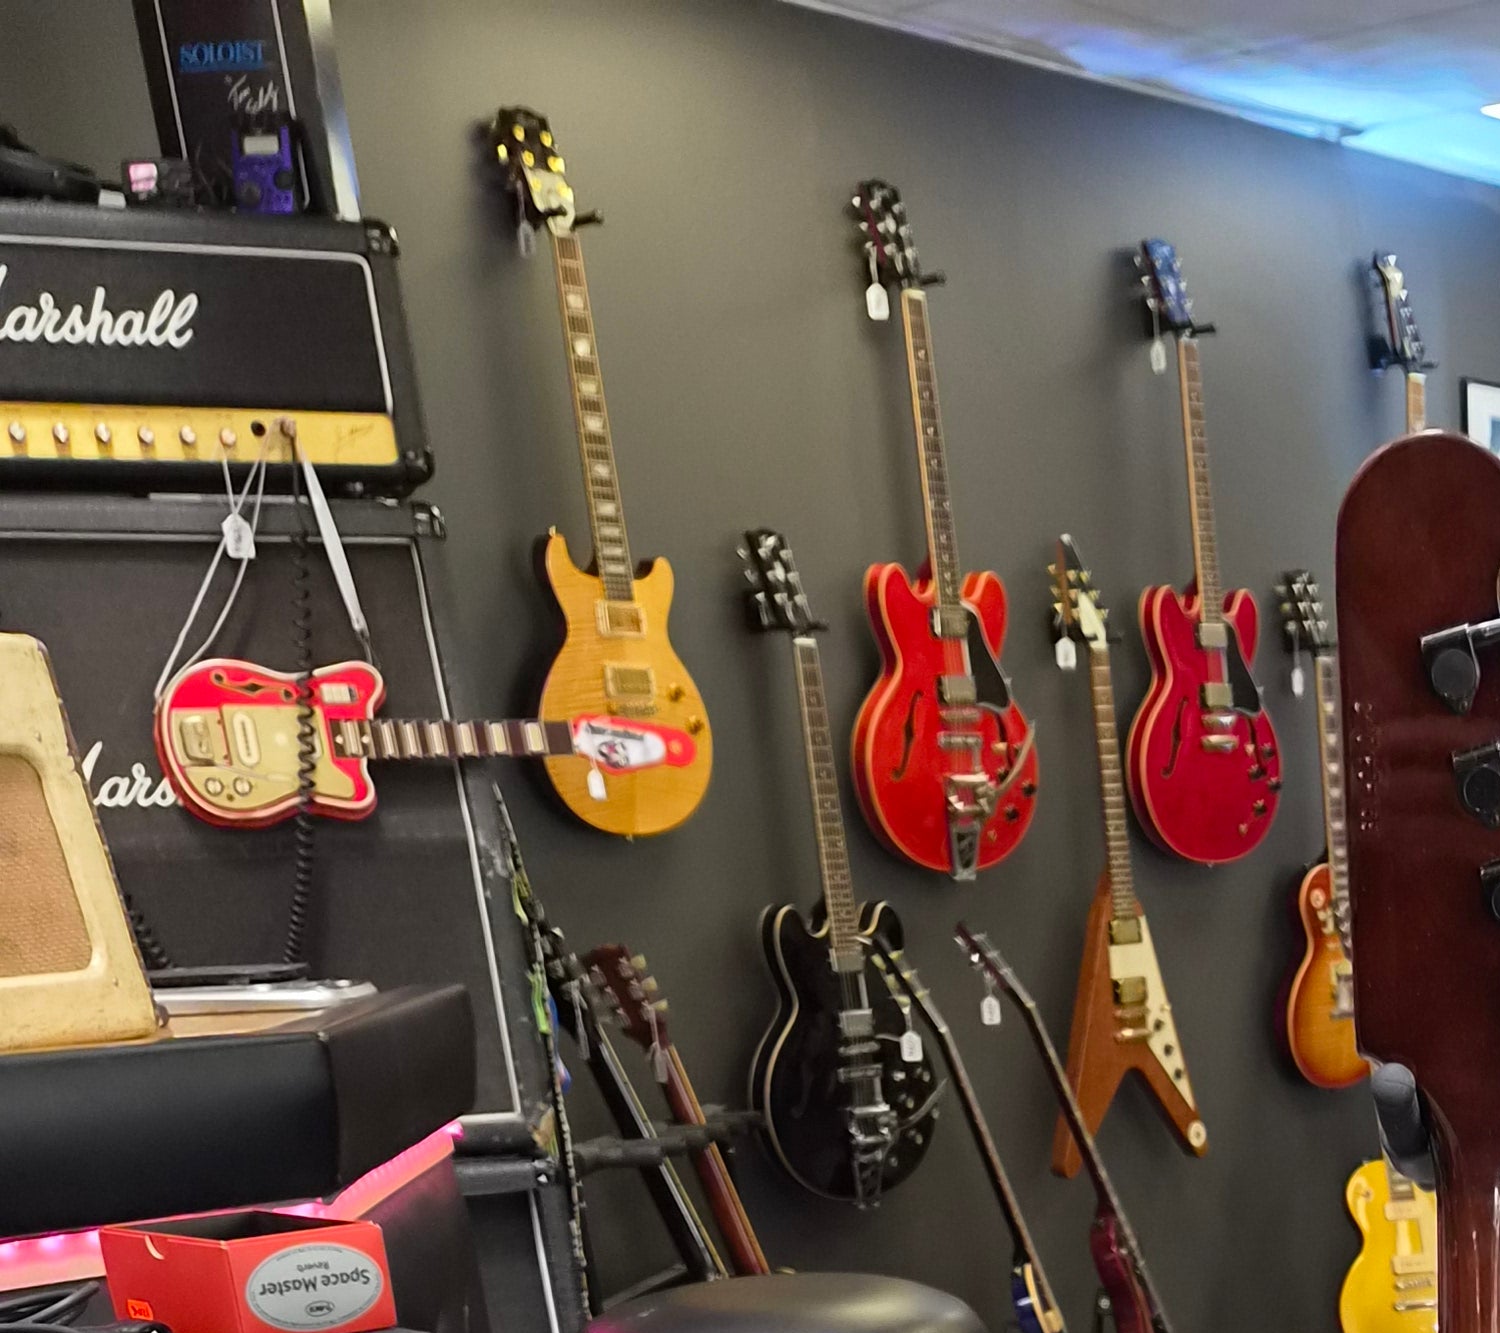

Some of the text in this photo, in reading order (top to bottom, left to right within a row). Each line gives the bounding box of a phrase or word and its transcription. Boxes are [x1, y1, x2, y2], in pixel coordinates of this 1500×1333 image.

[0, 263, 199, 349] arshall
[259, 1267, 370, 1296] Space Master
[297, 1261, 330, 1273] Reverb
